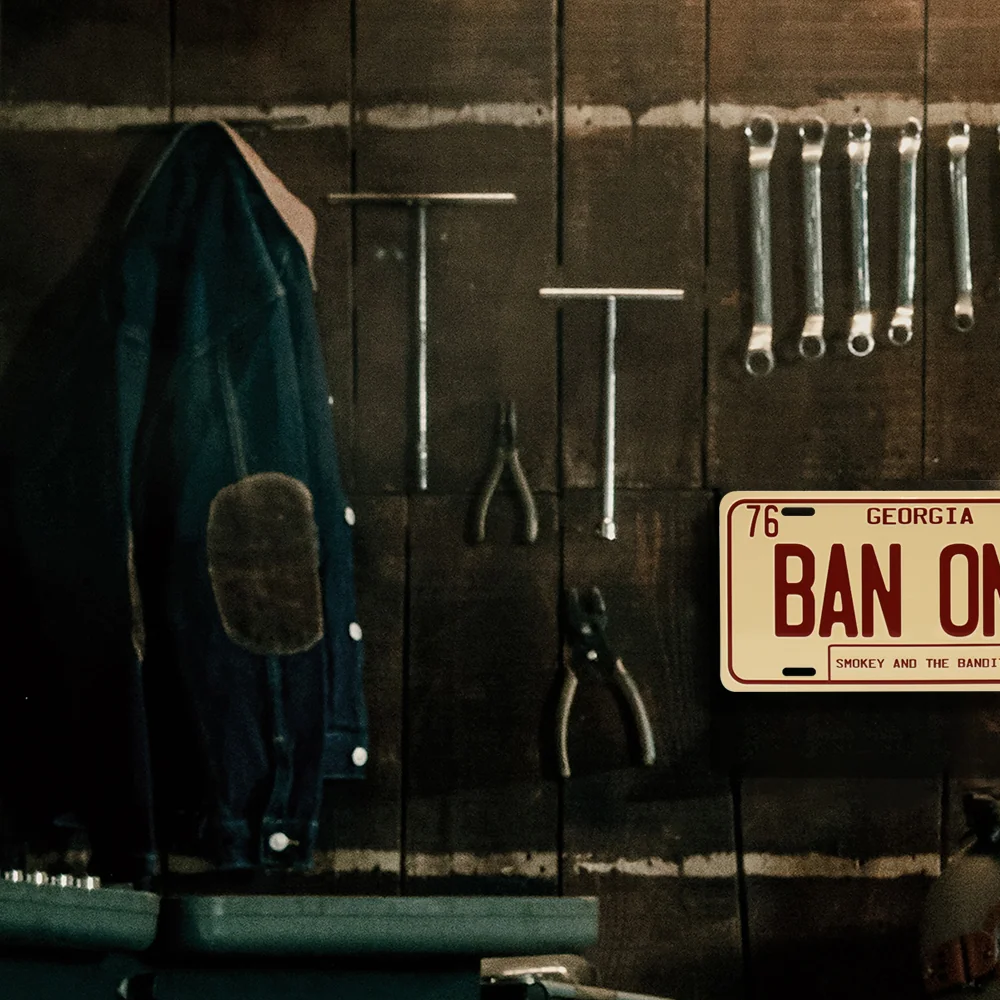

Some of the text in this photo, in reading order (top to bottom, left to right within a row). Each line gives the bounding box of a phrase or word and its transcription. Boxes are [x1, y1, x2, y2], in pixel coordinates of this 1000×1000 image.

[746, 505, 779, 537] 76
[866, 507, 974, 525] GEORGIA
[774, 543, 902, 638] BAN
[836, 658, 885, 669] SMOKEY
[893, 658, 917, 669] AND
[926, 658, 950, 669] THE
